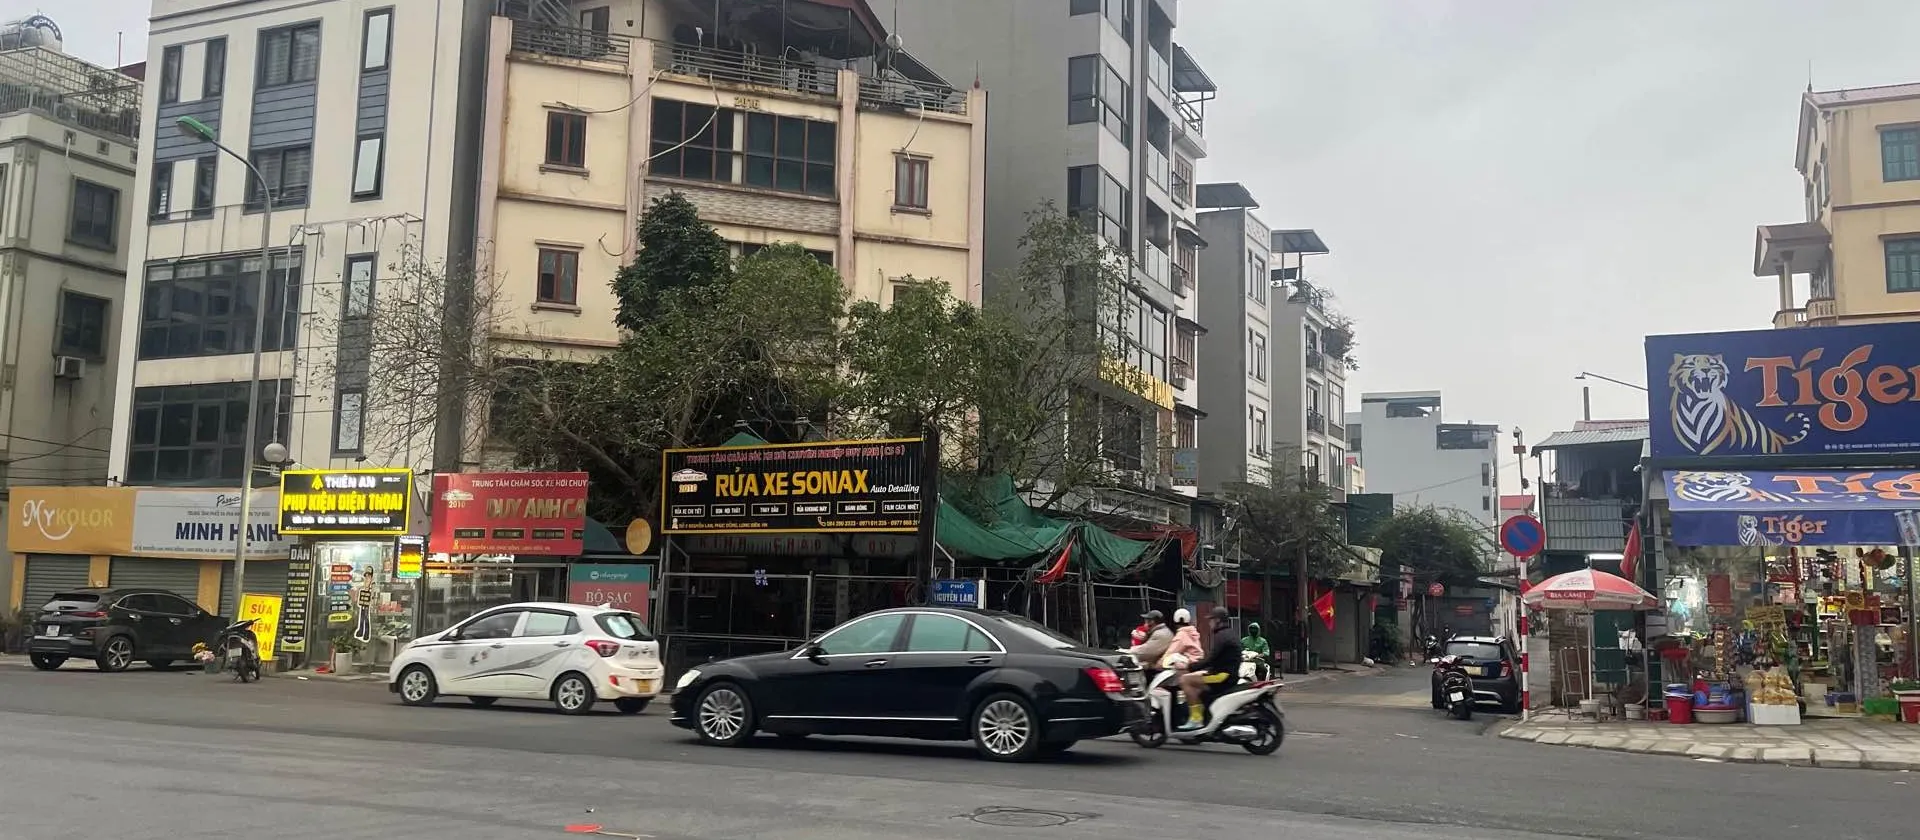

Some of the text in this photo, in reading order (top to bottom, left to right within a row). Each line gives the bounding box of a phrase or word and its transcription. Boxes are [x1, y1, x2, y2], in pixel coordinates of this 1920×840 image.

[325, 474, 375, 488] THIÊN AN
[472, 480, 493, 488] TRUNG
[716, 466, 919, 497] RỬA XE SONAX Auto Detailing
[1772, 472, 1920, 500] Tig
[283, 490, 403, 514] PHỤ KIỆN ĐIỆN THOẠI
[487, 498, 522, 518] DUY
[175, 522, 223, 541] MINH
[1762, 514, 1827, 543] Tiger
[251, 601, 272, 615] SỬA
[250, 620, 271, 636] IỆN
